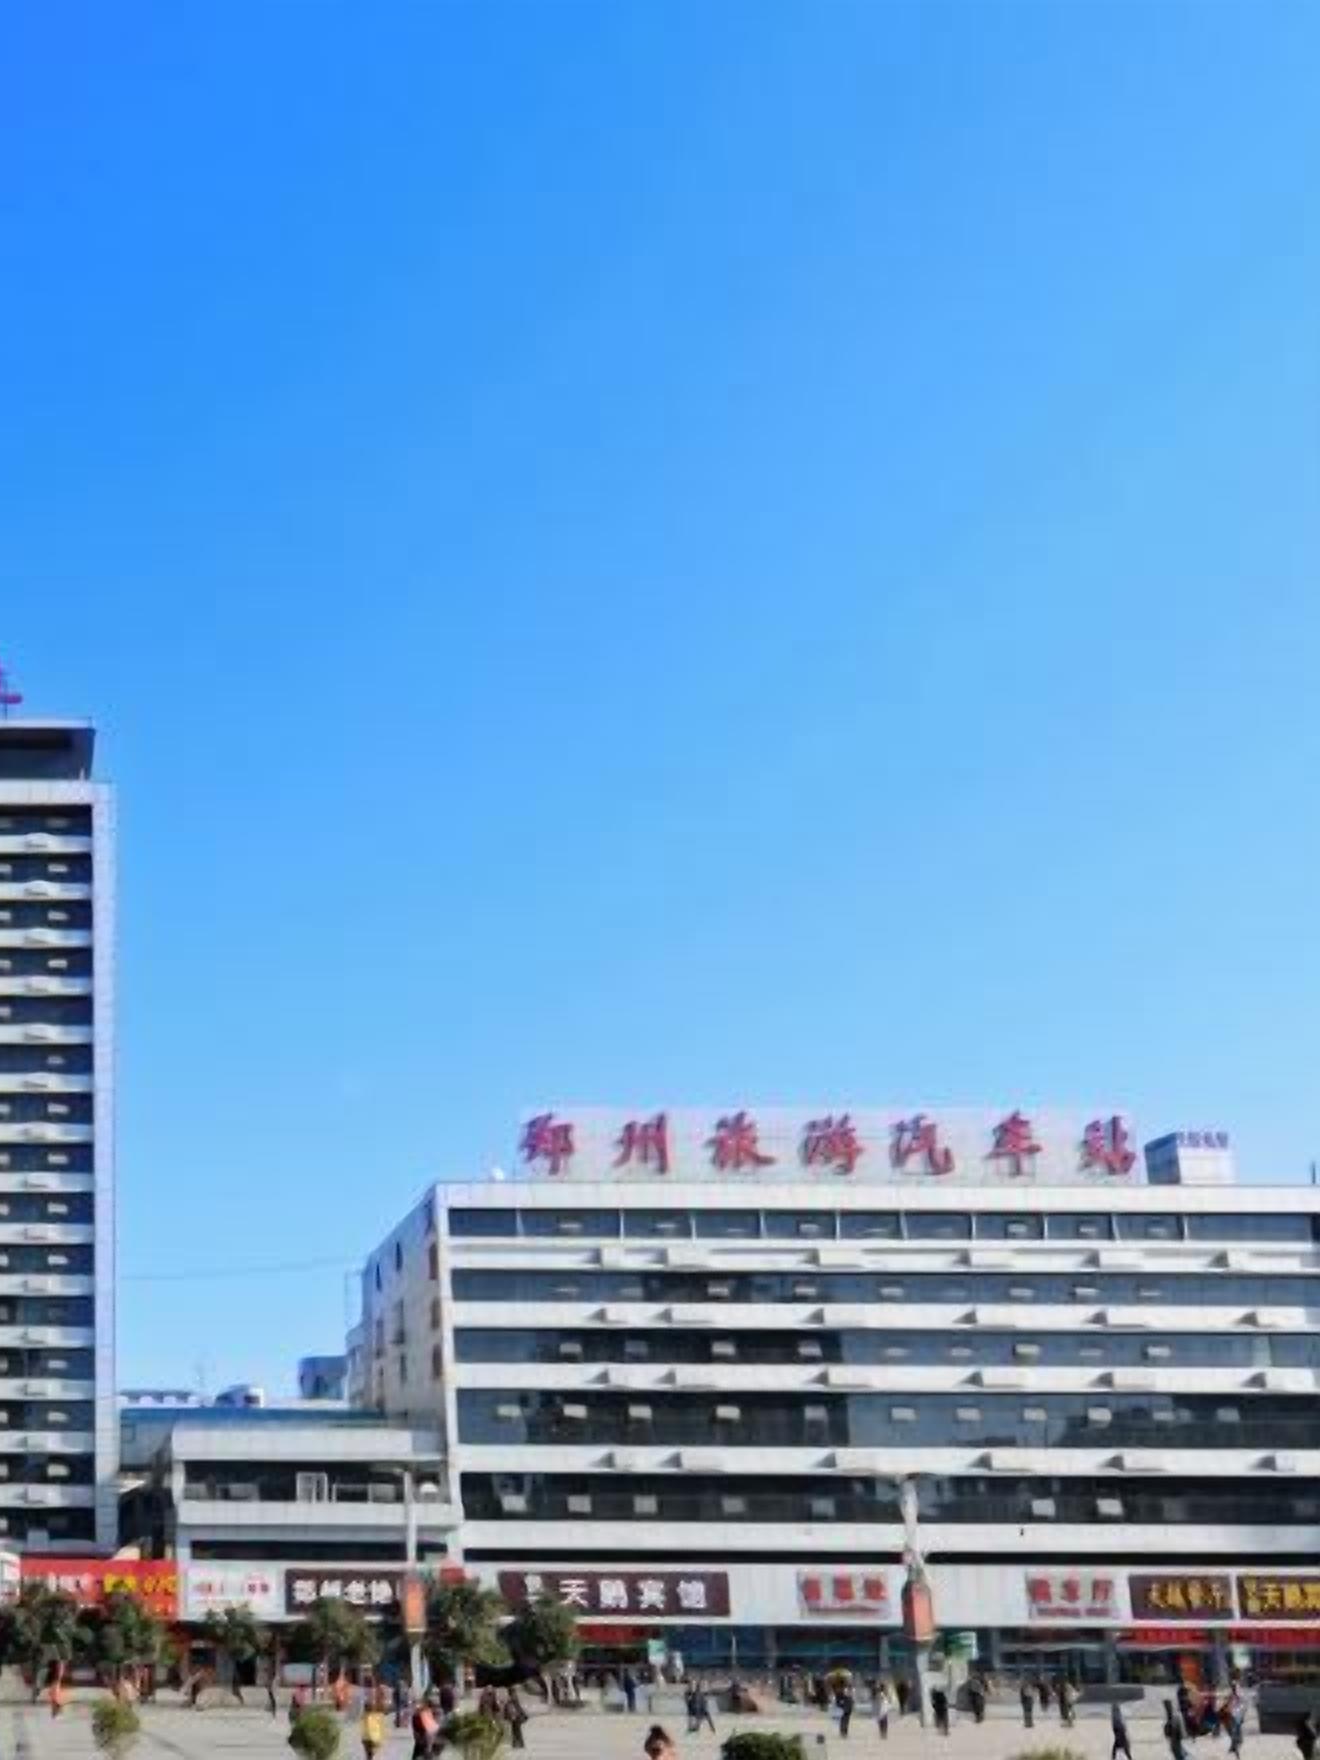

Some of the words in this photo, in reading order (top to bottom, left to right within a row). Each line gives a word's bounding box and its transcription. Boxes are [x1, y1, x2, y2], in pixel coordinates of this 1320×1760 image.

[519, 1110, 1137, 1177] 郑州旅游汽车站
